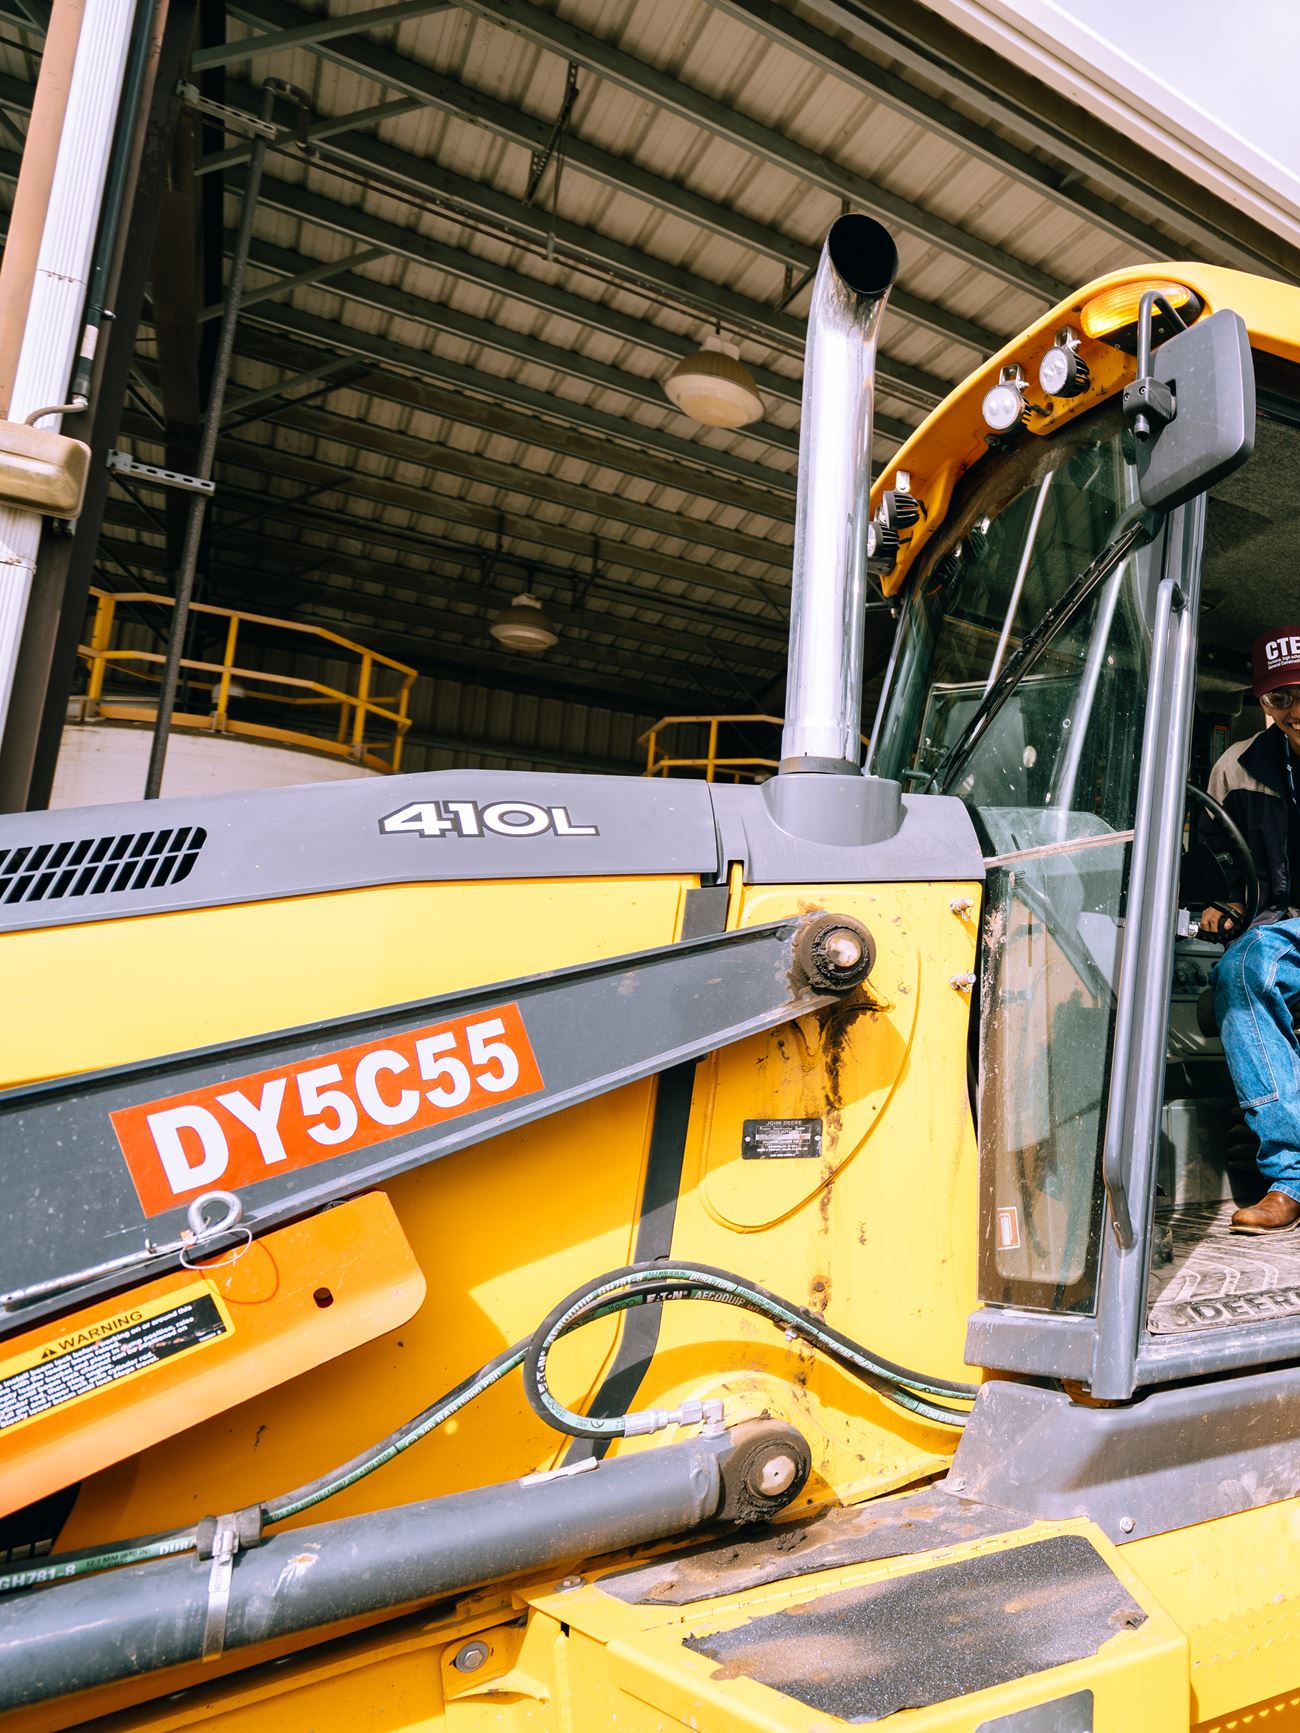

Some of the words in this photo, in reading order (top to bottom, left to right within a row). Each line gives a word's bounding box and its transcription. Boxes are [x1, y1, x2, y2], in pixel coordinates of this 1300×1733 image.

[379, 801, 600, 838] 410L
[147, 1017, 519, 1195] DY5C55
[58, 1311, 143, 1350] WARNING
[129, 1325, 141, 1334] on
[141, 1321, 151, 1330] or
[150, 1310, 177, 1325] around
[177, 1304, 192, 1314] this
[435, 1404, 458, 1423] BAR
